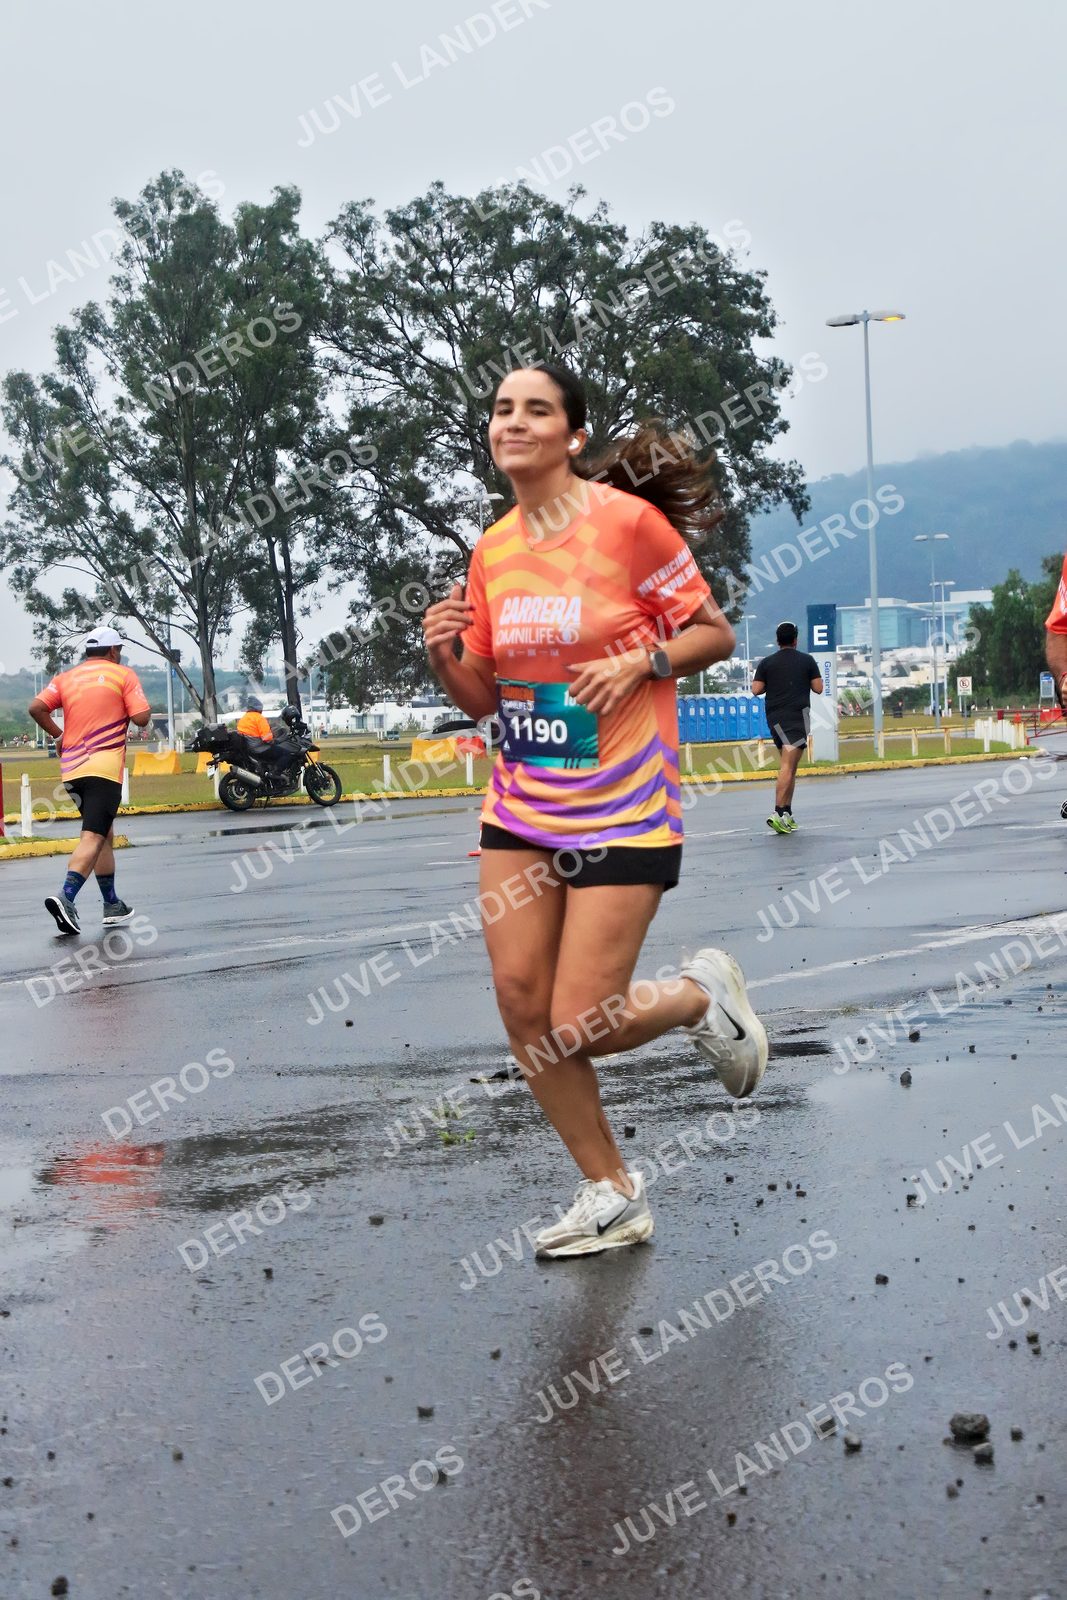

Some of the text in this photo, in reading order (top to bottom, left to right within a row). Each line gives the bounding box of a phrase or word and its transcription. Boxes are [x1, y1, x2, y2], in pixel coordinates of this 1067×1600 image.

[499, 596, 582, 625] CARRERA
[496, 627, 556, 646] OMNILIFE
[813, 625, 829, 646] E
[824, 661, 832, 697] General
[510, 715, 568, 744] 1190
